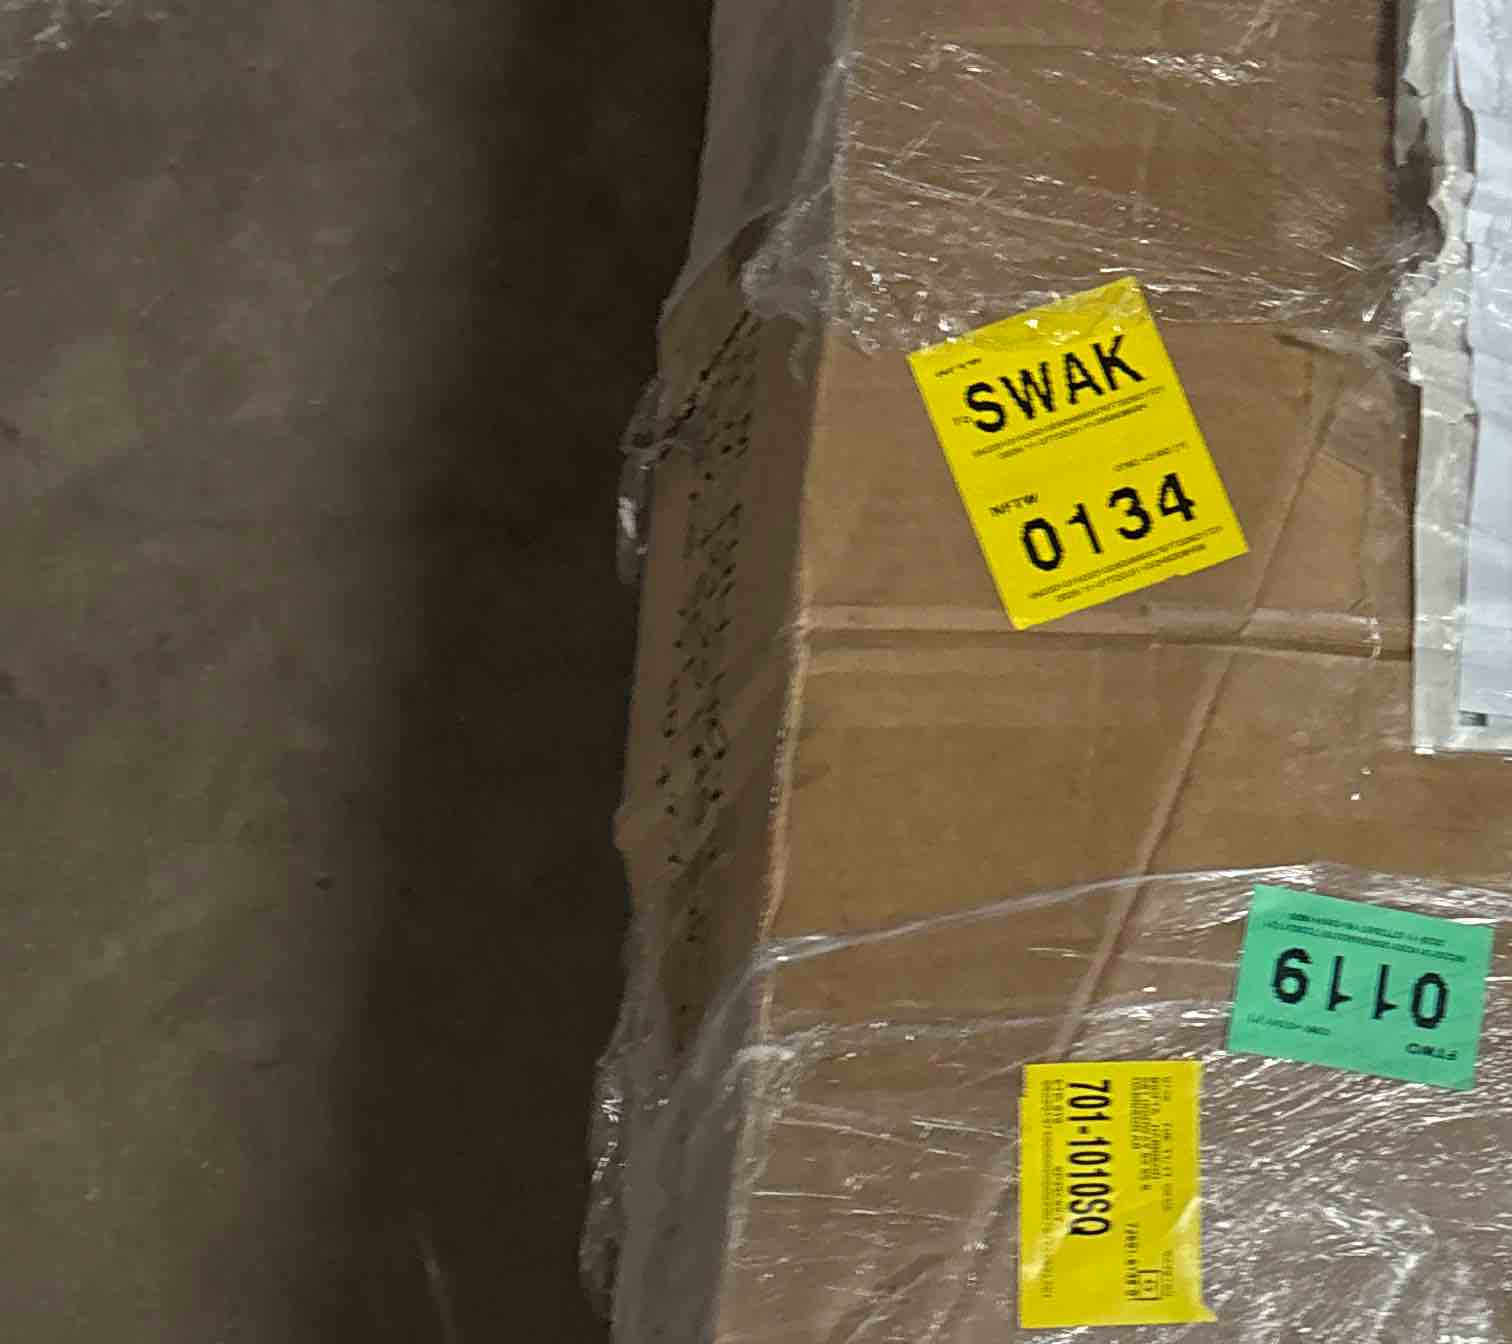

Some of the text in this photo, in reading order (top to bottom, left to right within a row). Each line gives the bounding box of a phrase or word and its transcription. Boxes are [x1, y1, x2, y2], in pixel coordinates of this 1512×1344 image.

[962, 334, 1146, 433] SWAK
[1018, 471, 1199, 573] 0134
[1271, 945, 1451, 1032] 0119
